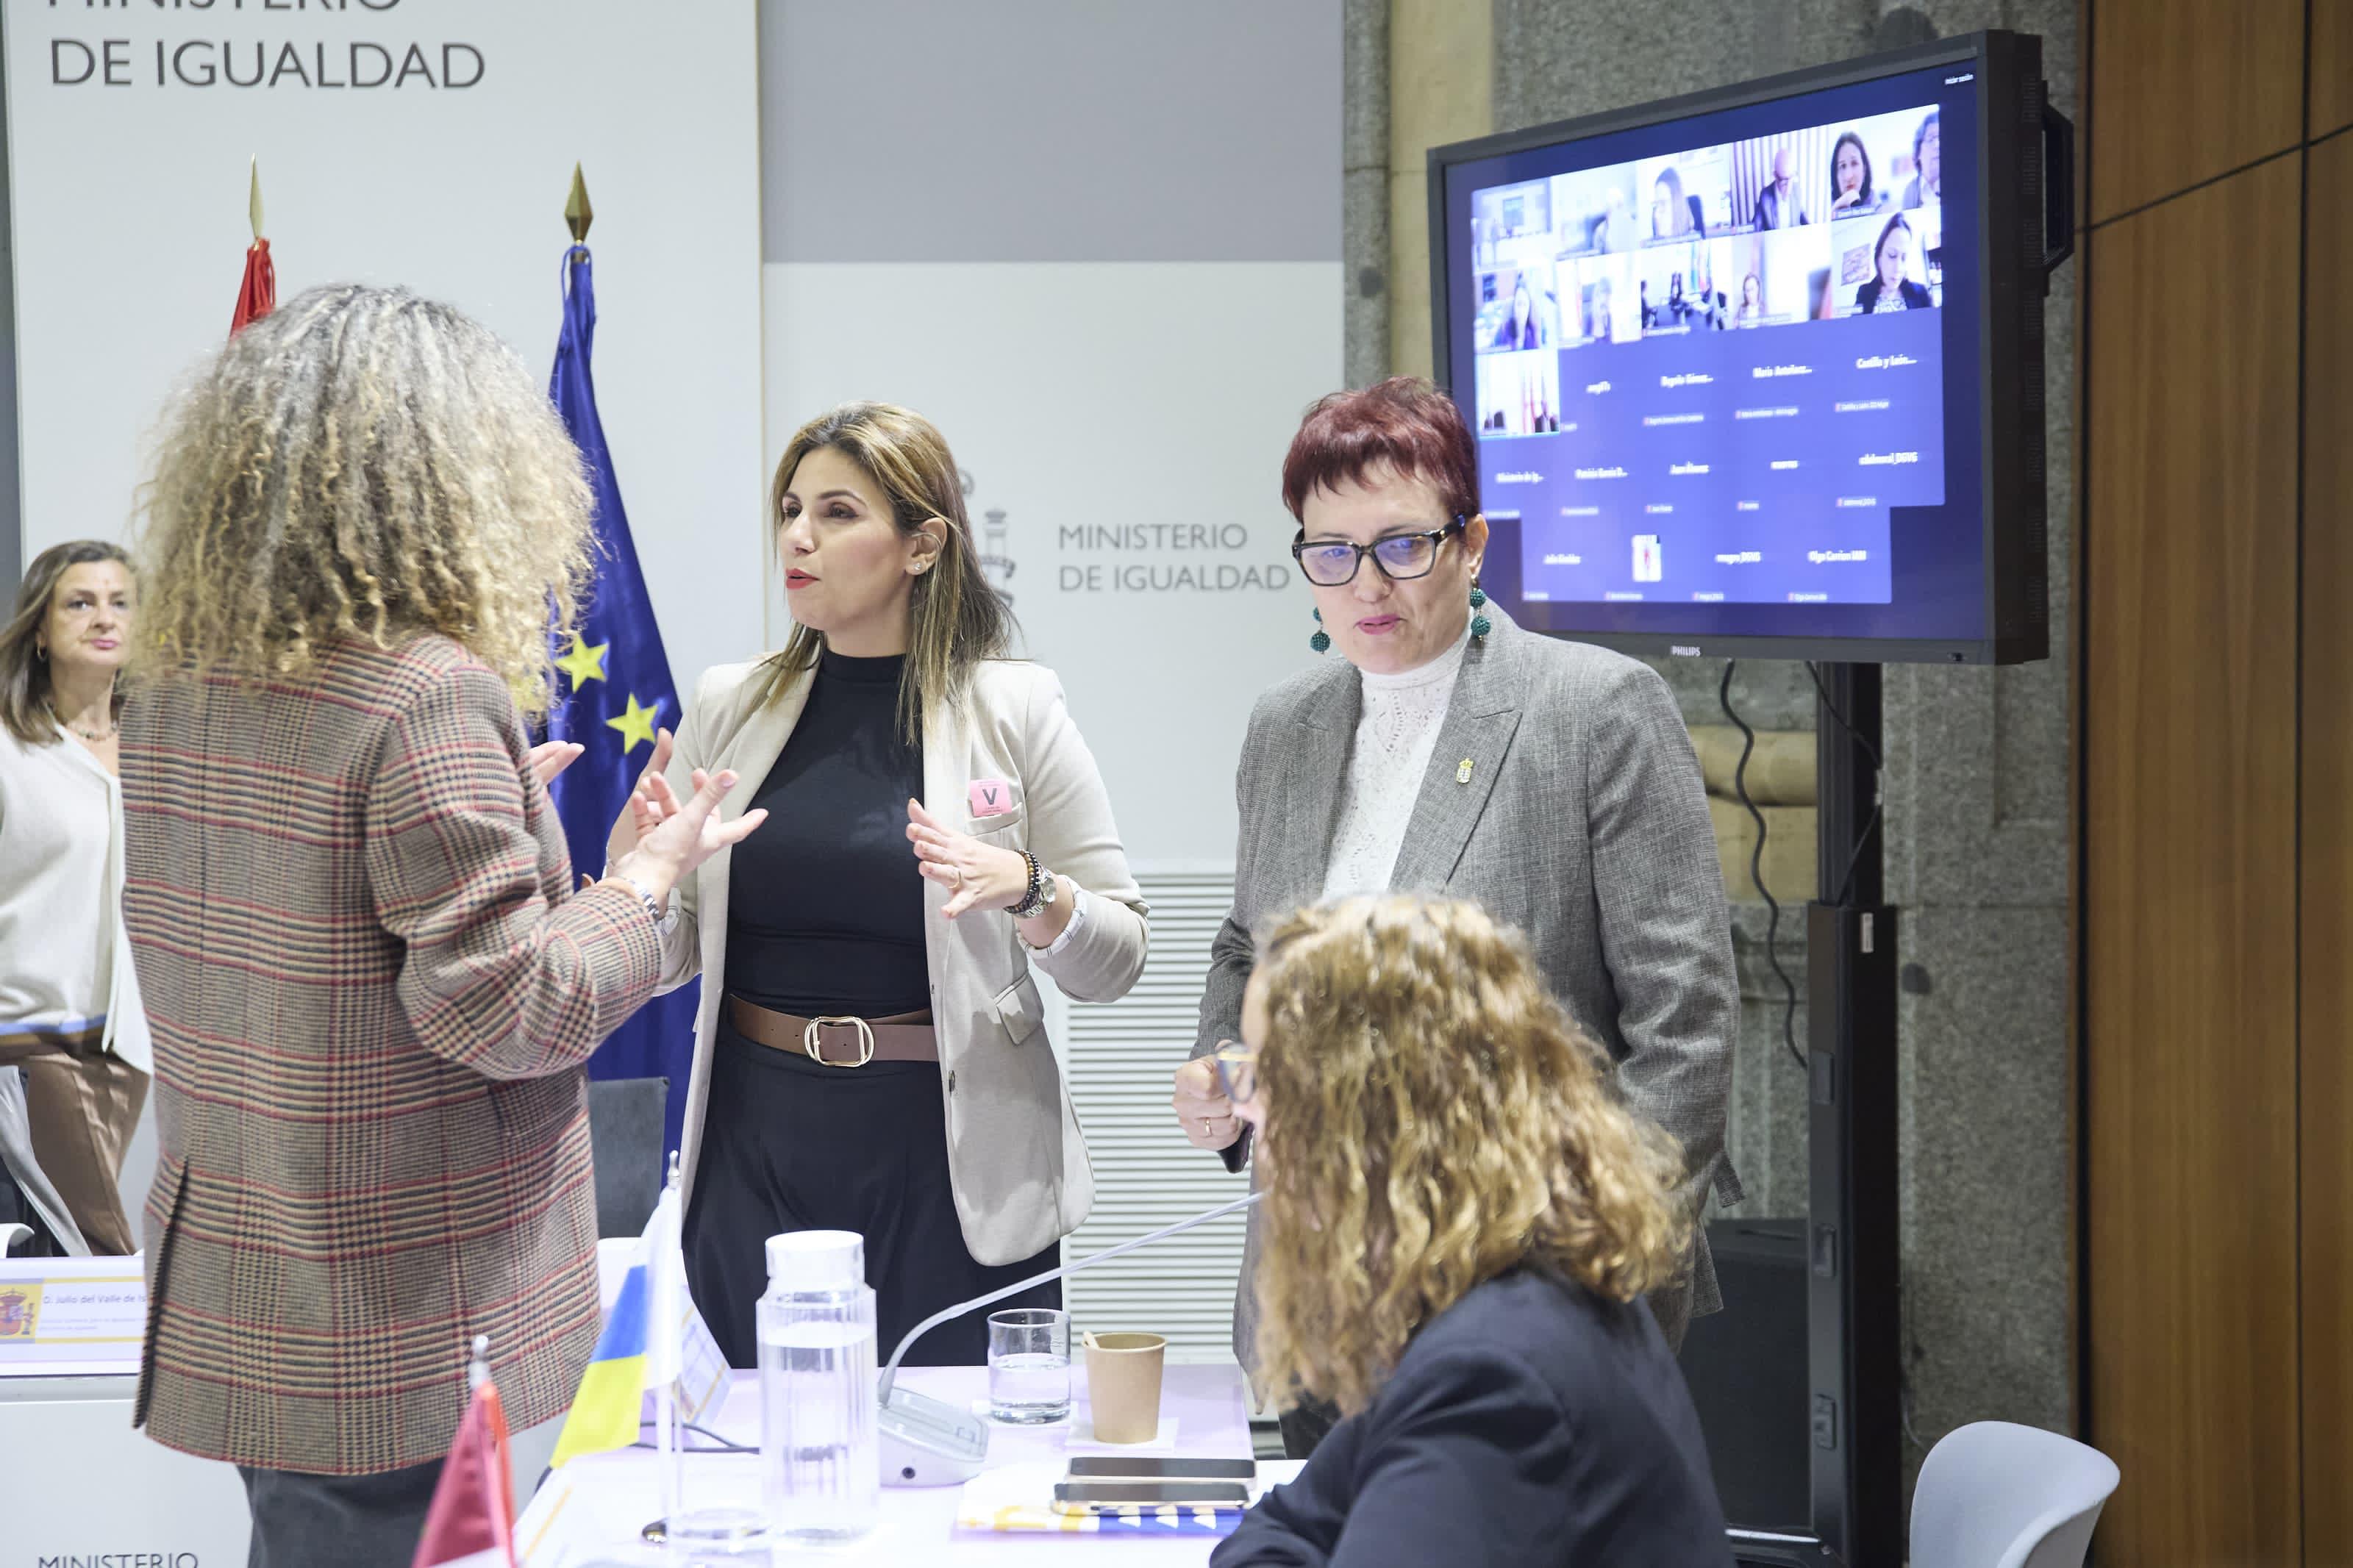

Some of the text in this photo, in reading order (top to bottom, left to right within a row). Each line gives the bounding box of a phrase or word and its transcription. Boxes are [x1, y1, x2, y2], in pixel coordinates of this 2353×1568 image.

[51, 39, 485, 89] DE IGUALDAD
[1059, 523, 1248, 551] MINISTERIO
[1059, 564, 1291, 592] DE IGUALDAD
[1671, 645, 1701, 657] PHILIPS
[982, 787, 997, 806] V
[80, 1293, 96, 1304] del
[124, 1293, 136, 1303] de
